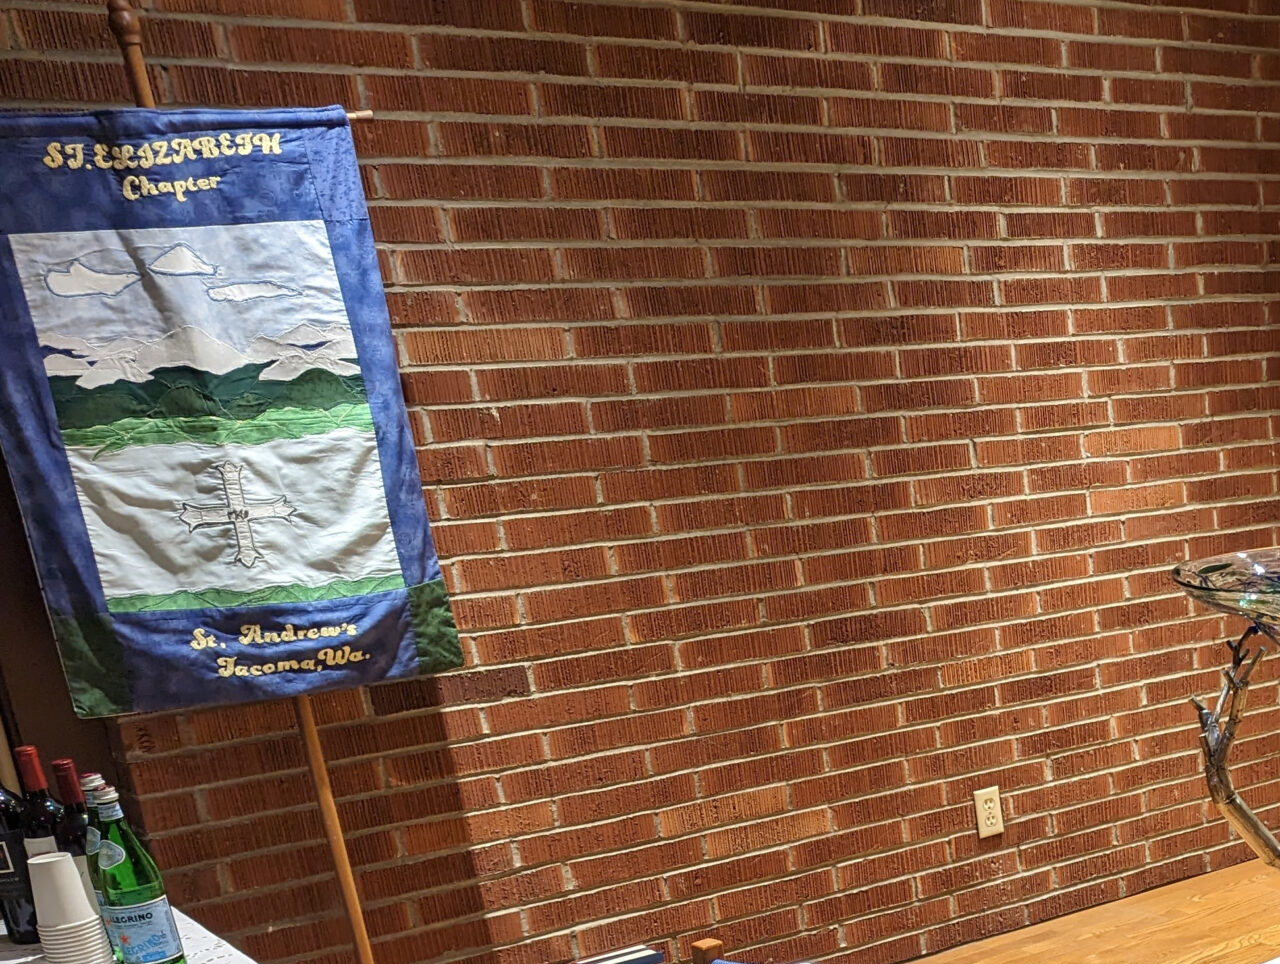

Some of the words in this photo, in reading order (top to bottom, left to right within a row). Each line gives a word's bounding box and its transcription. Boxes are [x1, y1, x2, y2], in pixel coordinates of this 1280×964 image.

[122, 175, 221, 202] Chapter
[190, 628, 226, 649] St.
[238, 623, 358, 645] Andrew's
